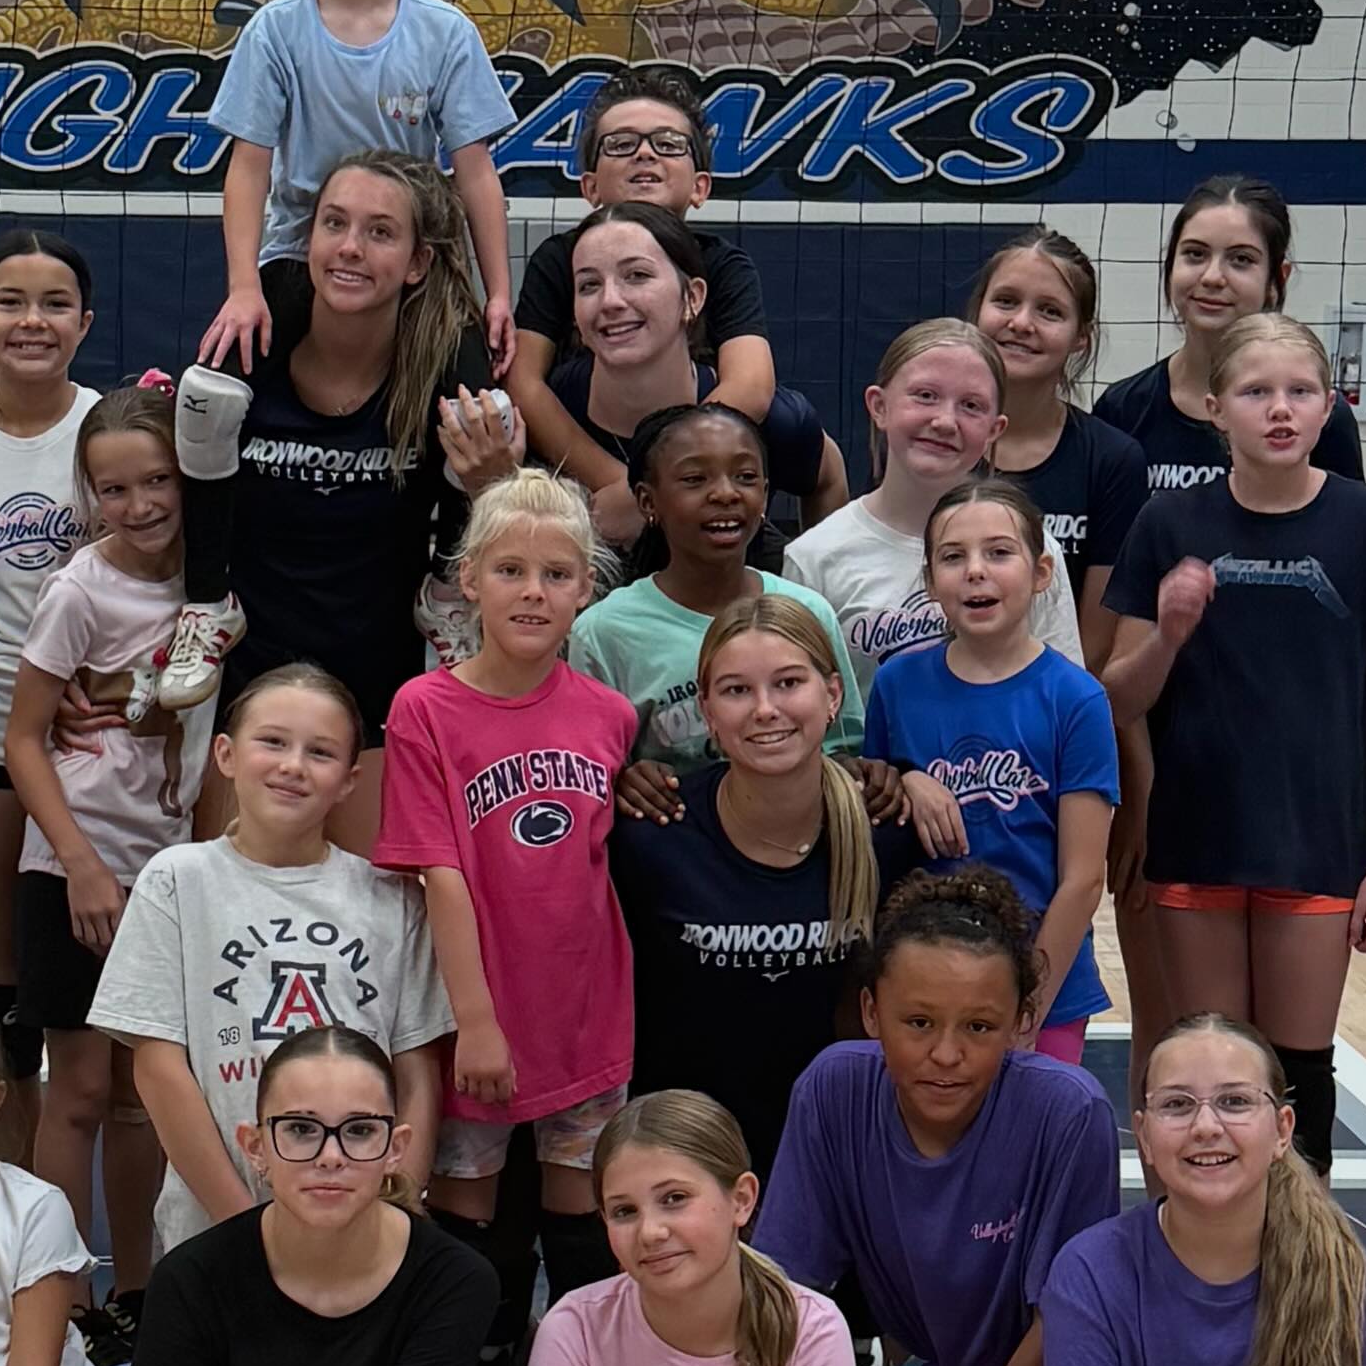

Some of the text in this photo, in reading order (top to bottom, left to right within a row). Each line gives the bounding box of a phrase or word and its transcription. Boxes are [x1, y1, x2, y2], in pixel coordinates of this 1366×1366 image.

[241, 437, 357, 471] IRONWOOD
[256, 462, 387, 483] VOLLEYBAL
[1043, 513, 1088, 539] RIDG
[851, 610, 945, 653] Volleyba
[464, 748, 608, 831] PENN STATE
[213, 918, 379, 1010] ARIZONA
[252, 960, 346, 1041] A
[218, 1026, 241, 1046] 18
